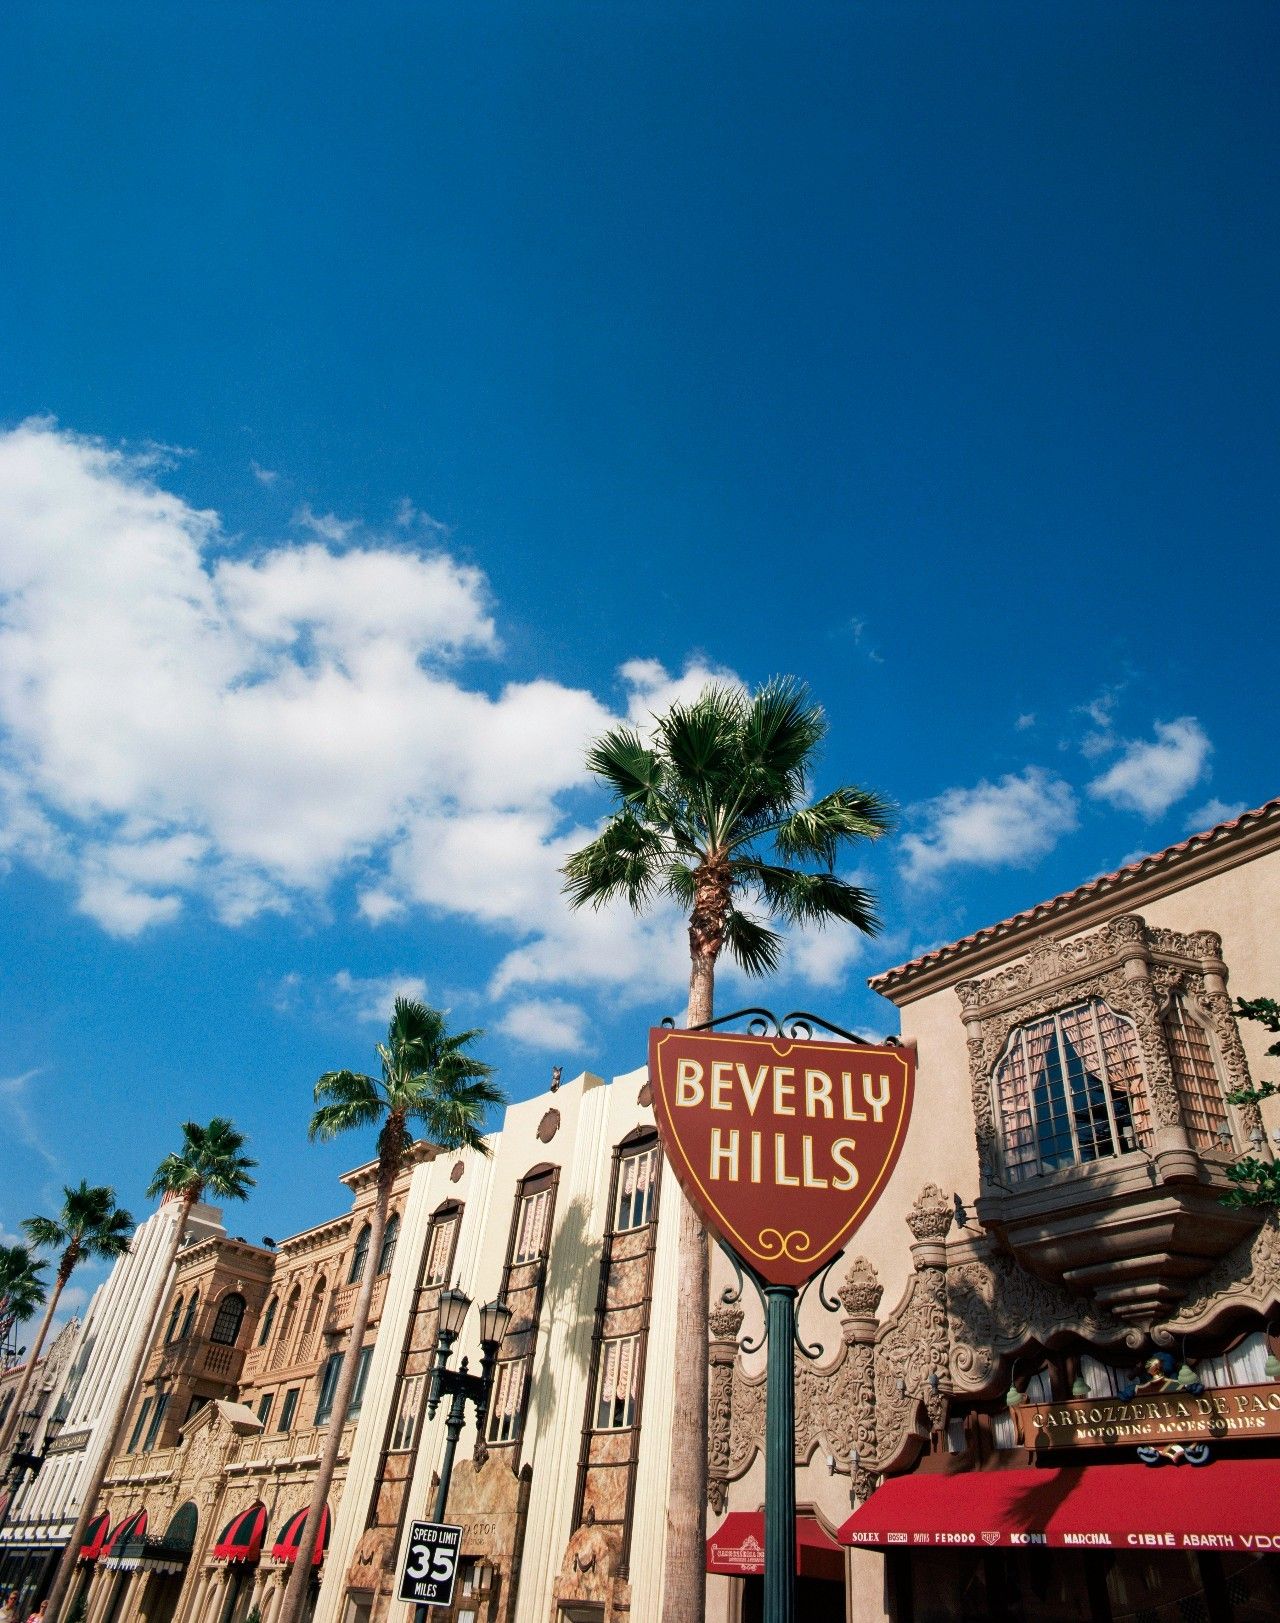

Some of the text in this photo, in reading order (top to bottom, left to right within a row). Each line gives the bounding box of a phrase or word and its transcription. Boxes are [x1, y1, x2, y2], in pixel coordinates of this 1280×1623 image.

[675, 1058, 891, 1123] BEVERLY
[709, 1127, 859, 1191] HILLS
[1032, 1402, 1190, 1428] CARROZZERIA
[1196, 1397, 1230, 1415] DE
[1076, 1416, 1265, 1439] MOTORING ACCESSORIES
[413, 1528, 437, 1543] SPEED
[438, 1530, 459, 1545] LIMIT
[852, 1532, 880, 1542] SOLEX
[935, 1532, 976, 1543] FERODO
[1010, 1533, 1047, 1544] KONI
[1063, 1533, 1112, 1545] MARCHAL
[1182, 1534, 1234, 1547] ABARTH
[406, 1544, 455, 1582] 35
[414, 1582, 438, 1598] MILES
